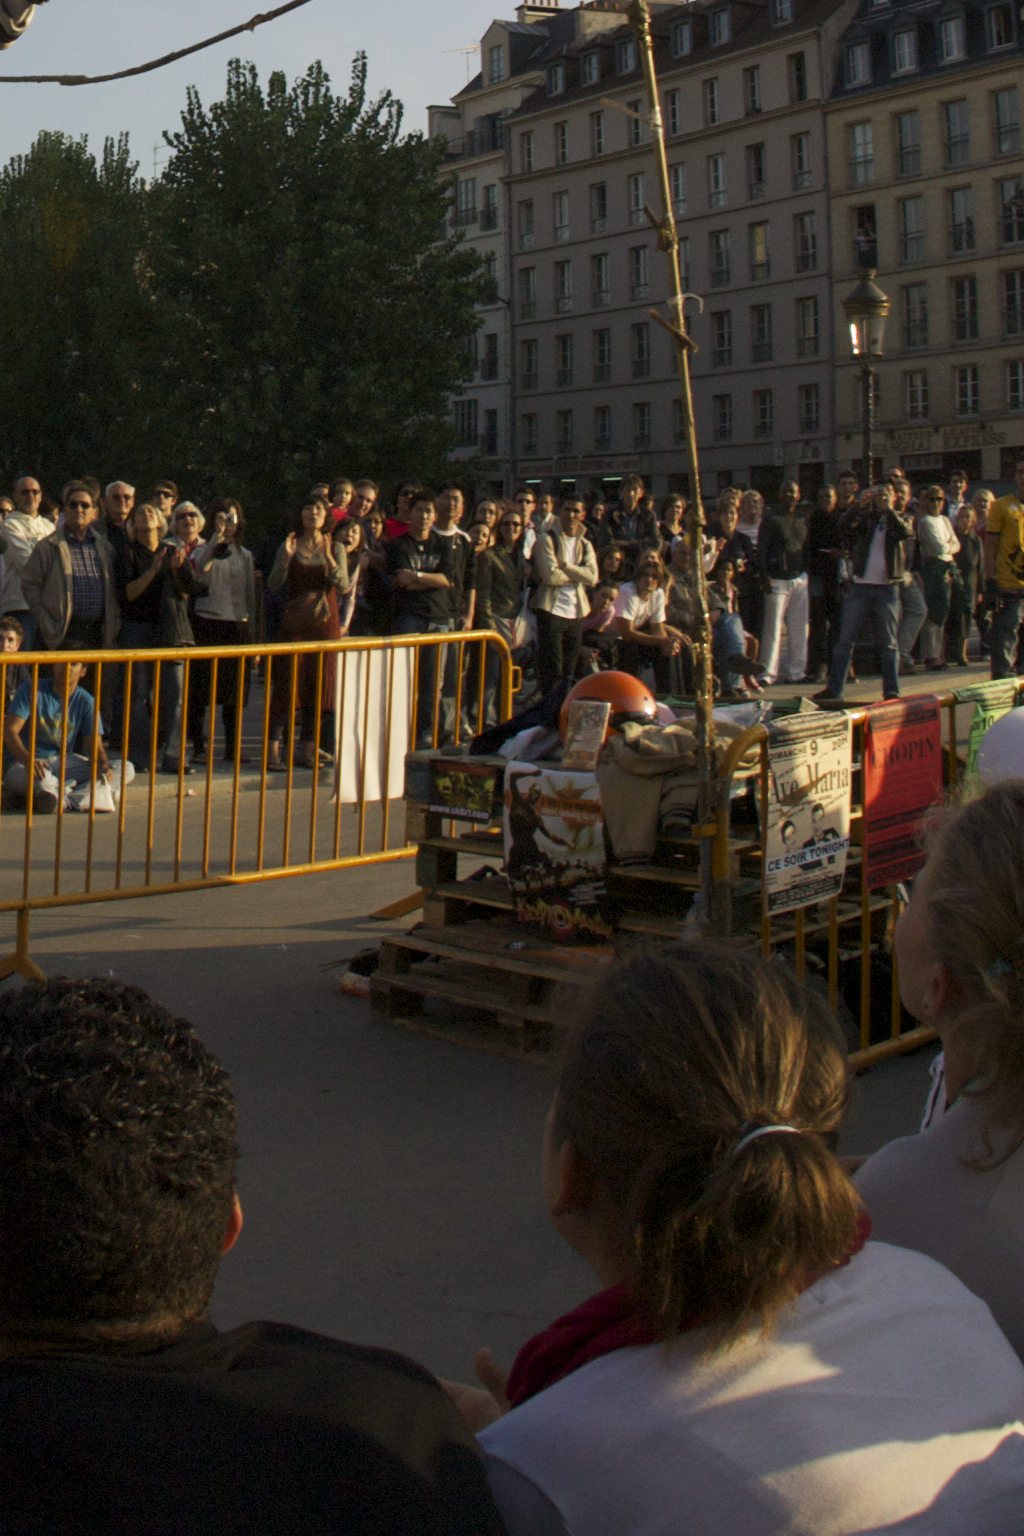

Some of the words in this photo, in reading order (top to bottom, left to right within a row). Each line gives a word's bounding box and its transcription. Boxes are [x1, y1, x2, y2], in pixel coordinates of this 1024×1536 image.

[871, 438, 932, 454] HANGHAI
[943, 432, 1007, 450] EXPRESS
[810, 737, 818, 756] 9
[871, 737, 935, 770] CHOPIN
[770, 770, 799, 804] Ave
[806, 759, 849, 795] Maria
[767, 857, 782, 872] CE
[783, 851, 807, 868] SOIR
[809, 838, 849, 859] TONIGHT
